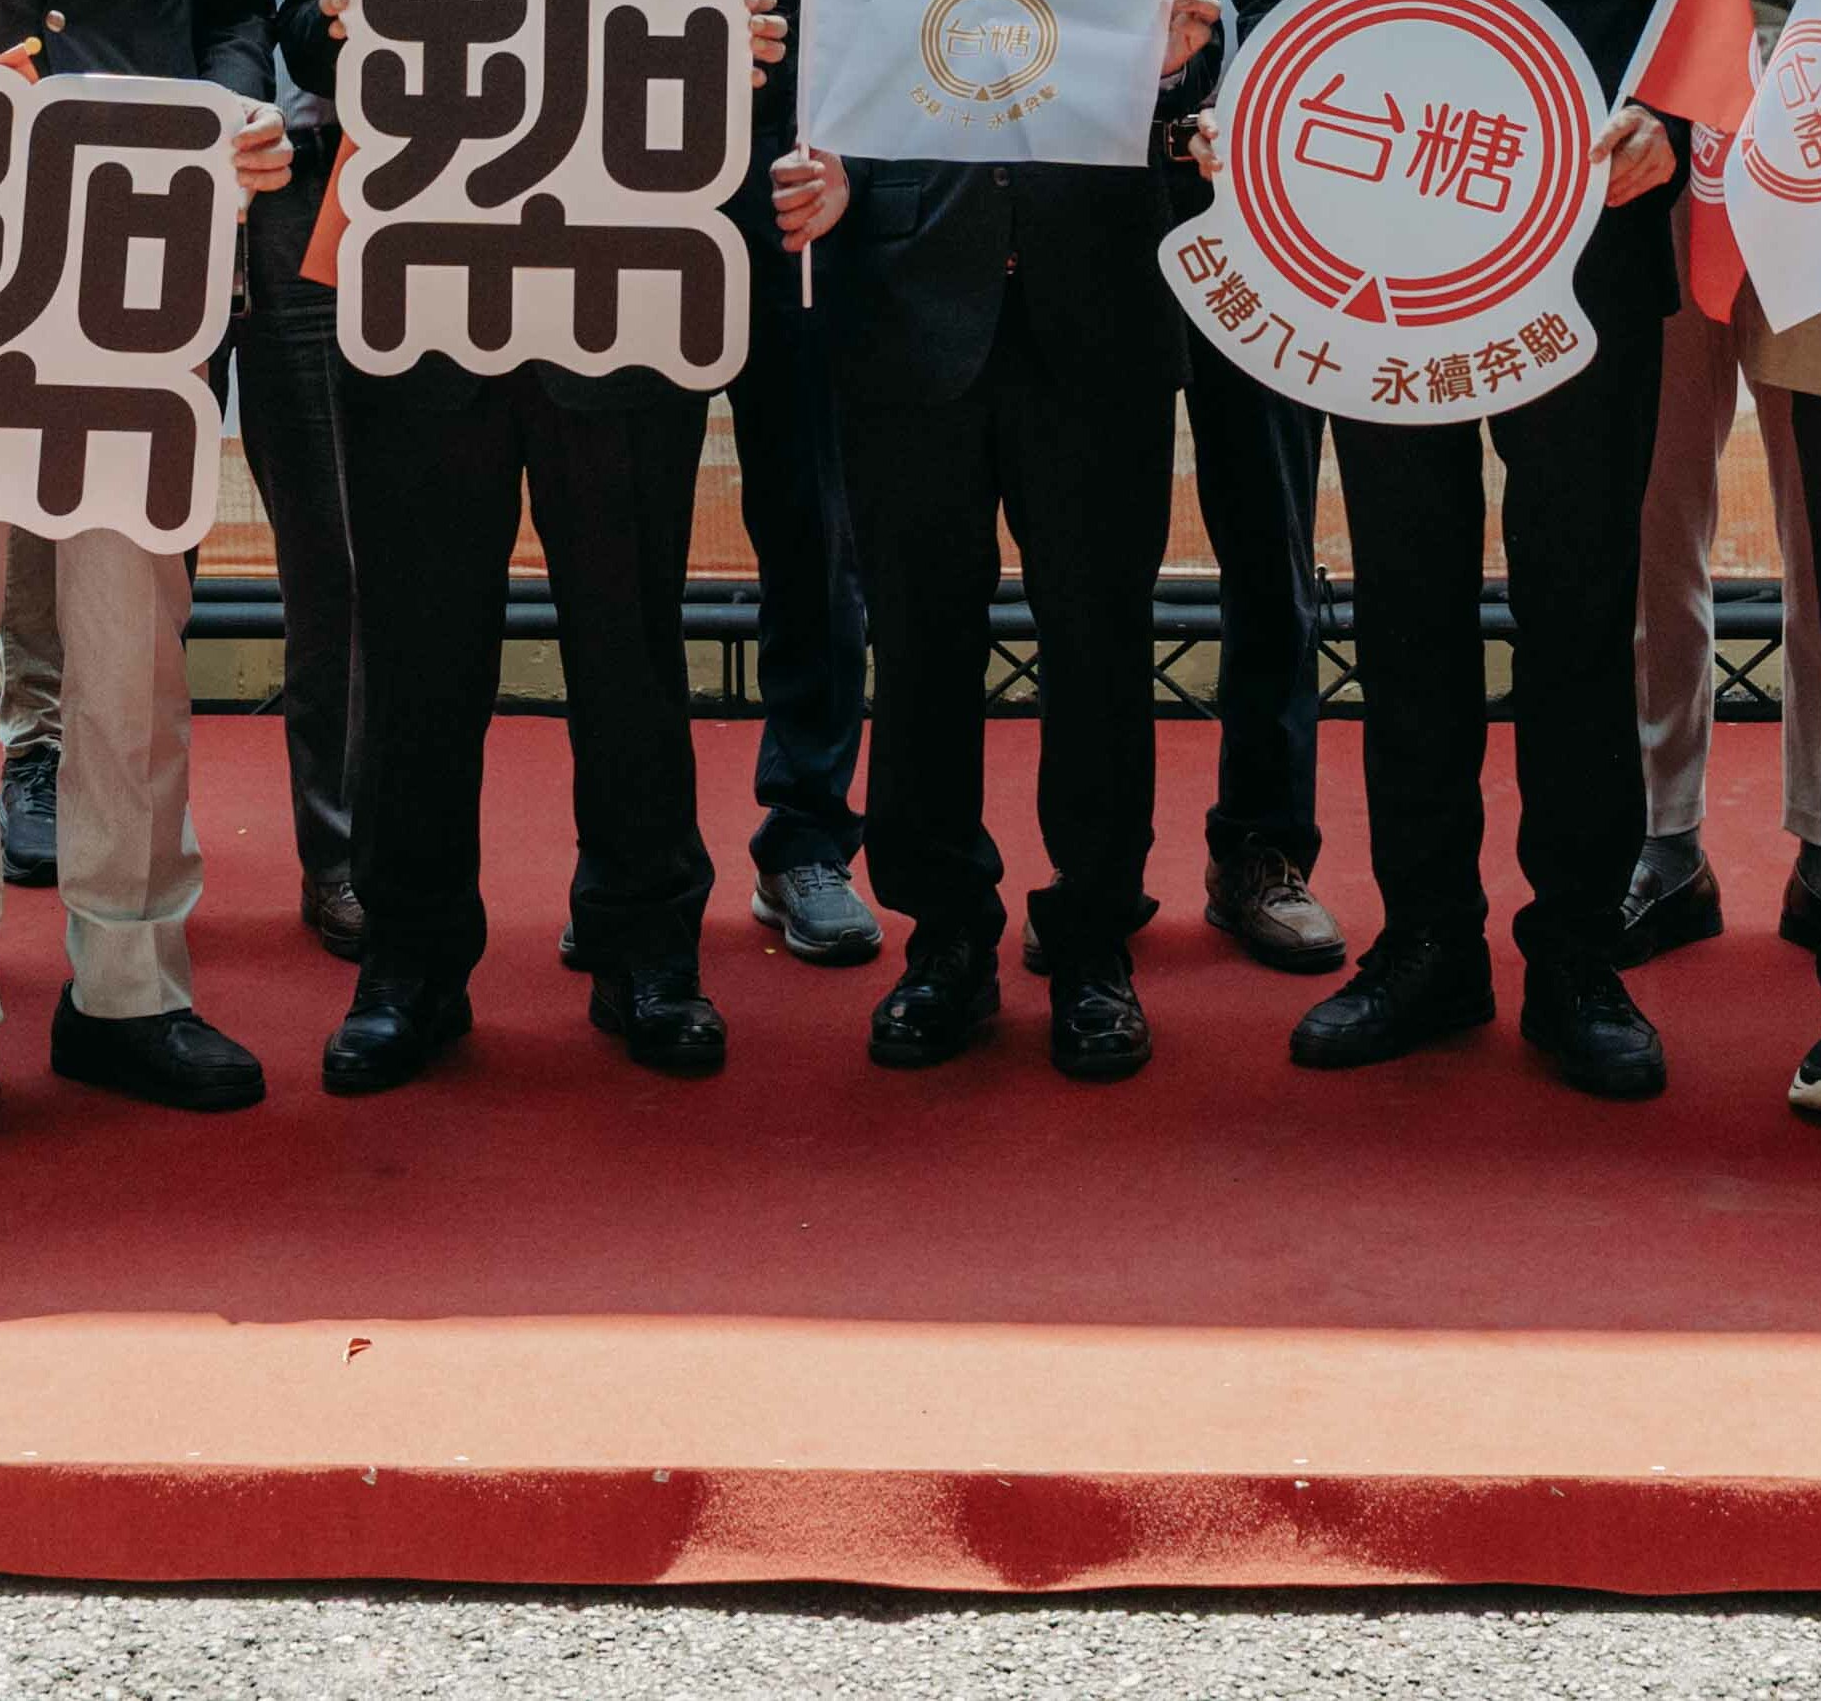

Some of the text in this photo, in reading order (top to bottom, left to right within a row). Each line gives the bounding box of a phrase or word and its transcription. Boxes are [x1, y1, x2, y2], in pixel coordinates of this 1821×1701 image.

[946, 18, 1031, 58] 台糖
[1294, 72, 1528, 213] 台糖
[1178, 234, 1578, 405] 台糖八十 永續奔馳
